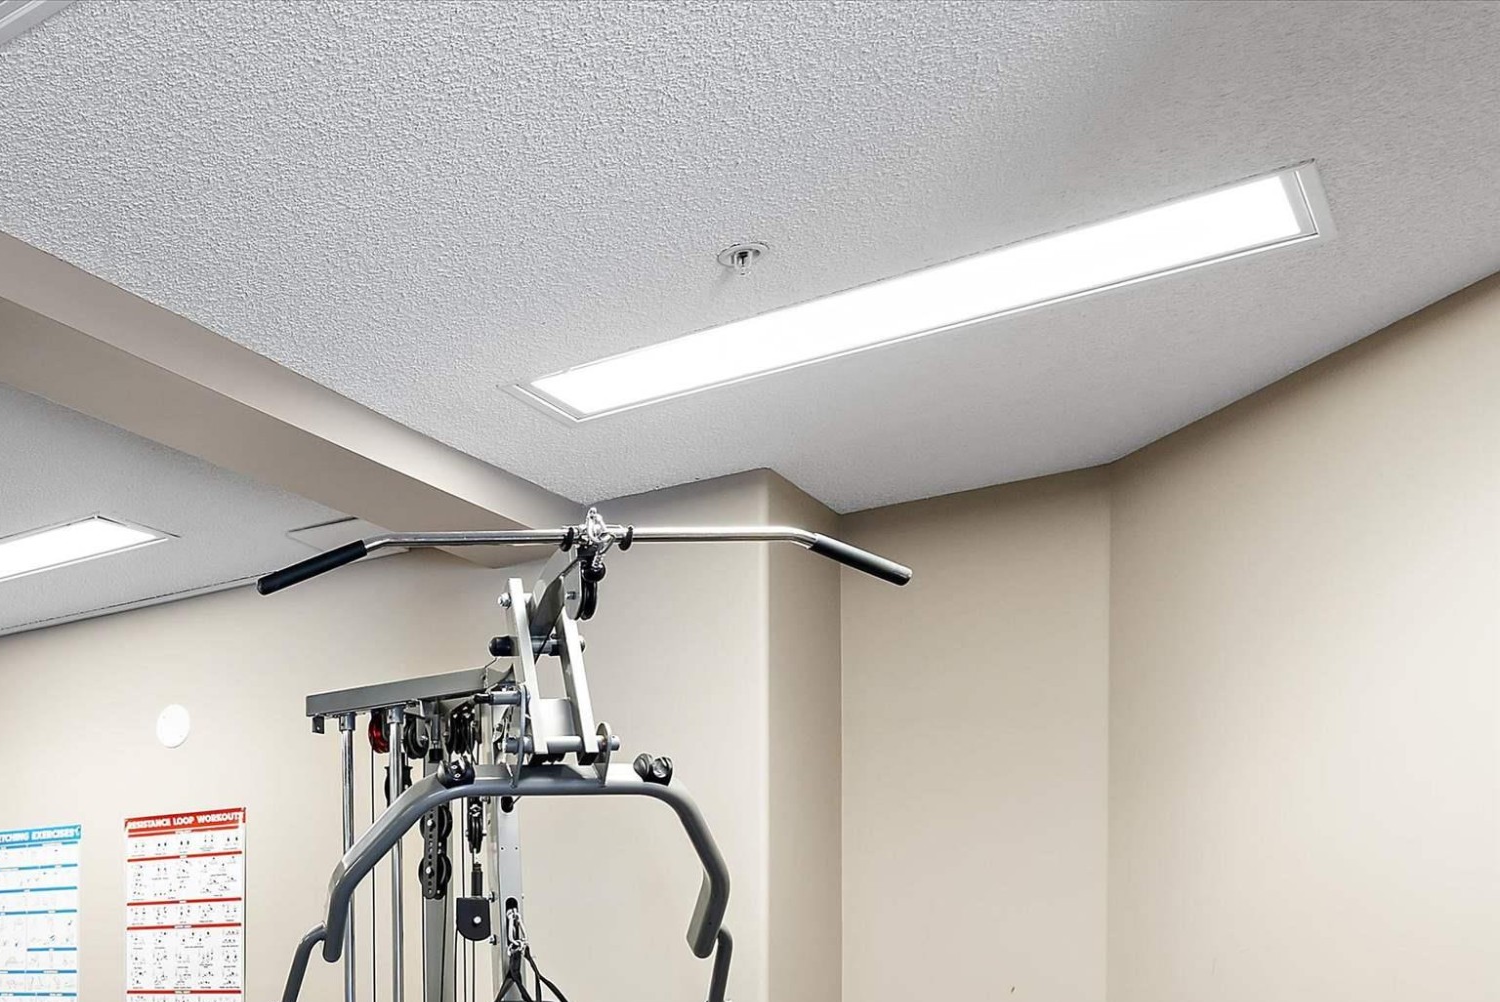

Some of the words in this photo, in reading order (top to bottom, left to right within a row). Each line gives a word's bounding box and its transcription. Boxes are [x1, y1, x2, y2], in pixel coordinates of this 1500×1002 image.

[128, 818, 171, 829] RESISTANCE
[173, 816, 194, 826] LOOP
[31, 828, 76, 840] EXERCISES
